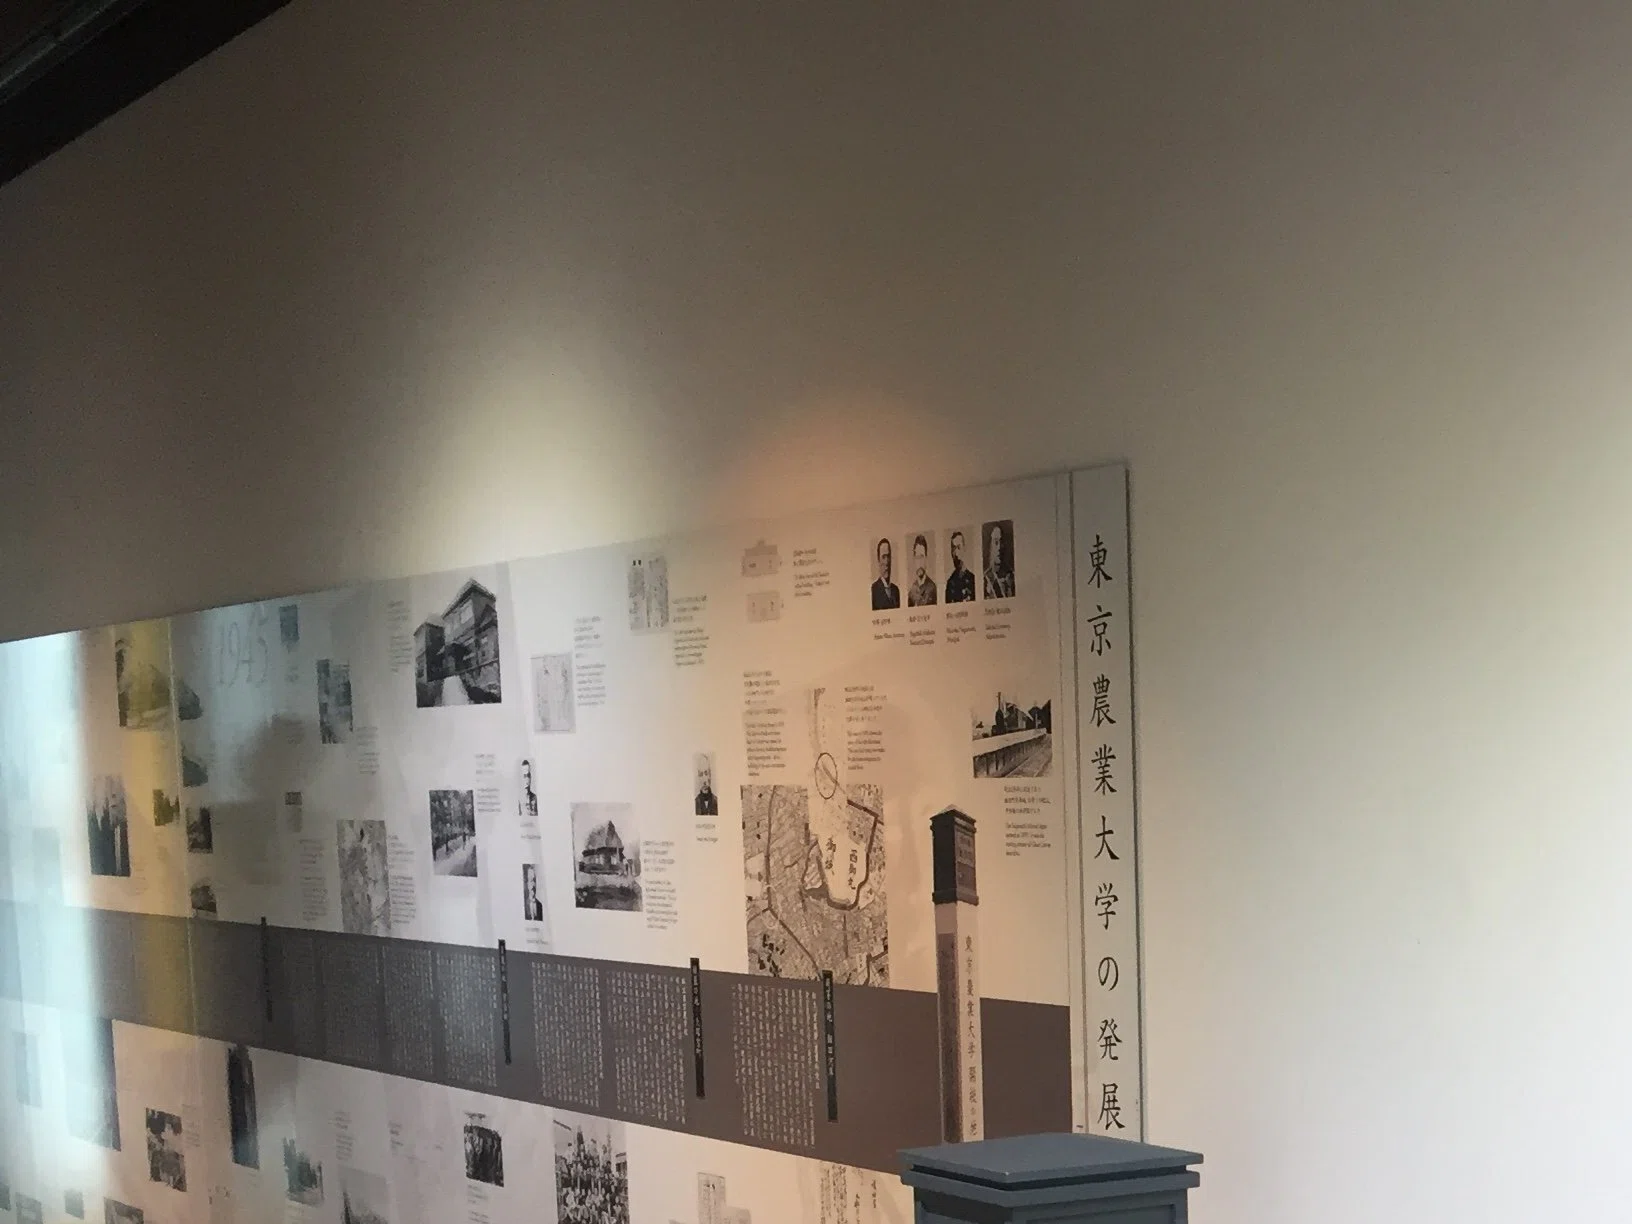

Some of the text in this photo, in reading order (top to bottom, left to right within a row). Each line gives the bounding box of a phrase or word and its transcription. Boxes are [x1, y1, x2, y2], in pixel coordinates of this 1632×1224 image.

[1087, 534, 1126, 1131] 東京農業大学の発展
